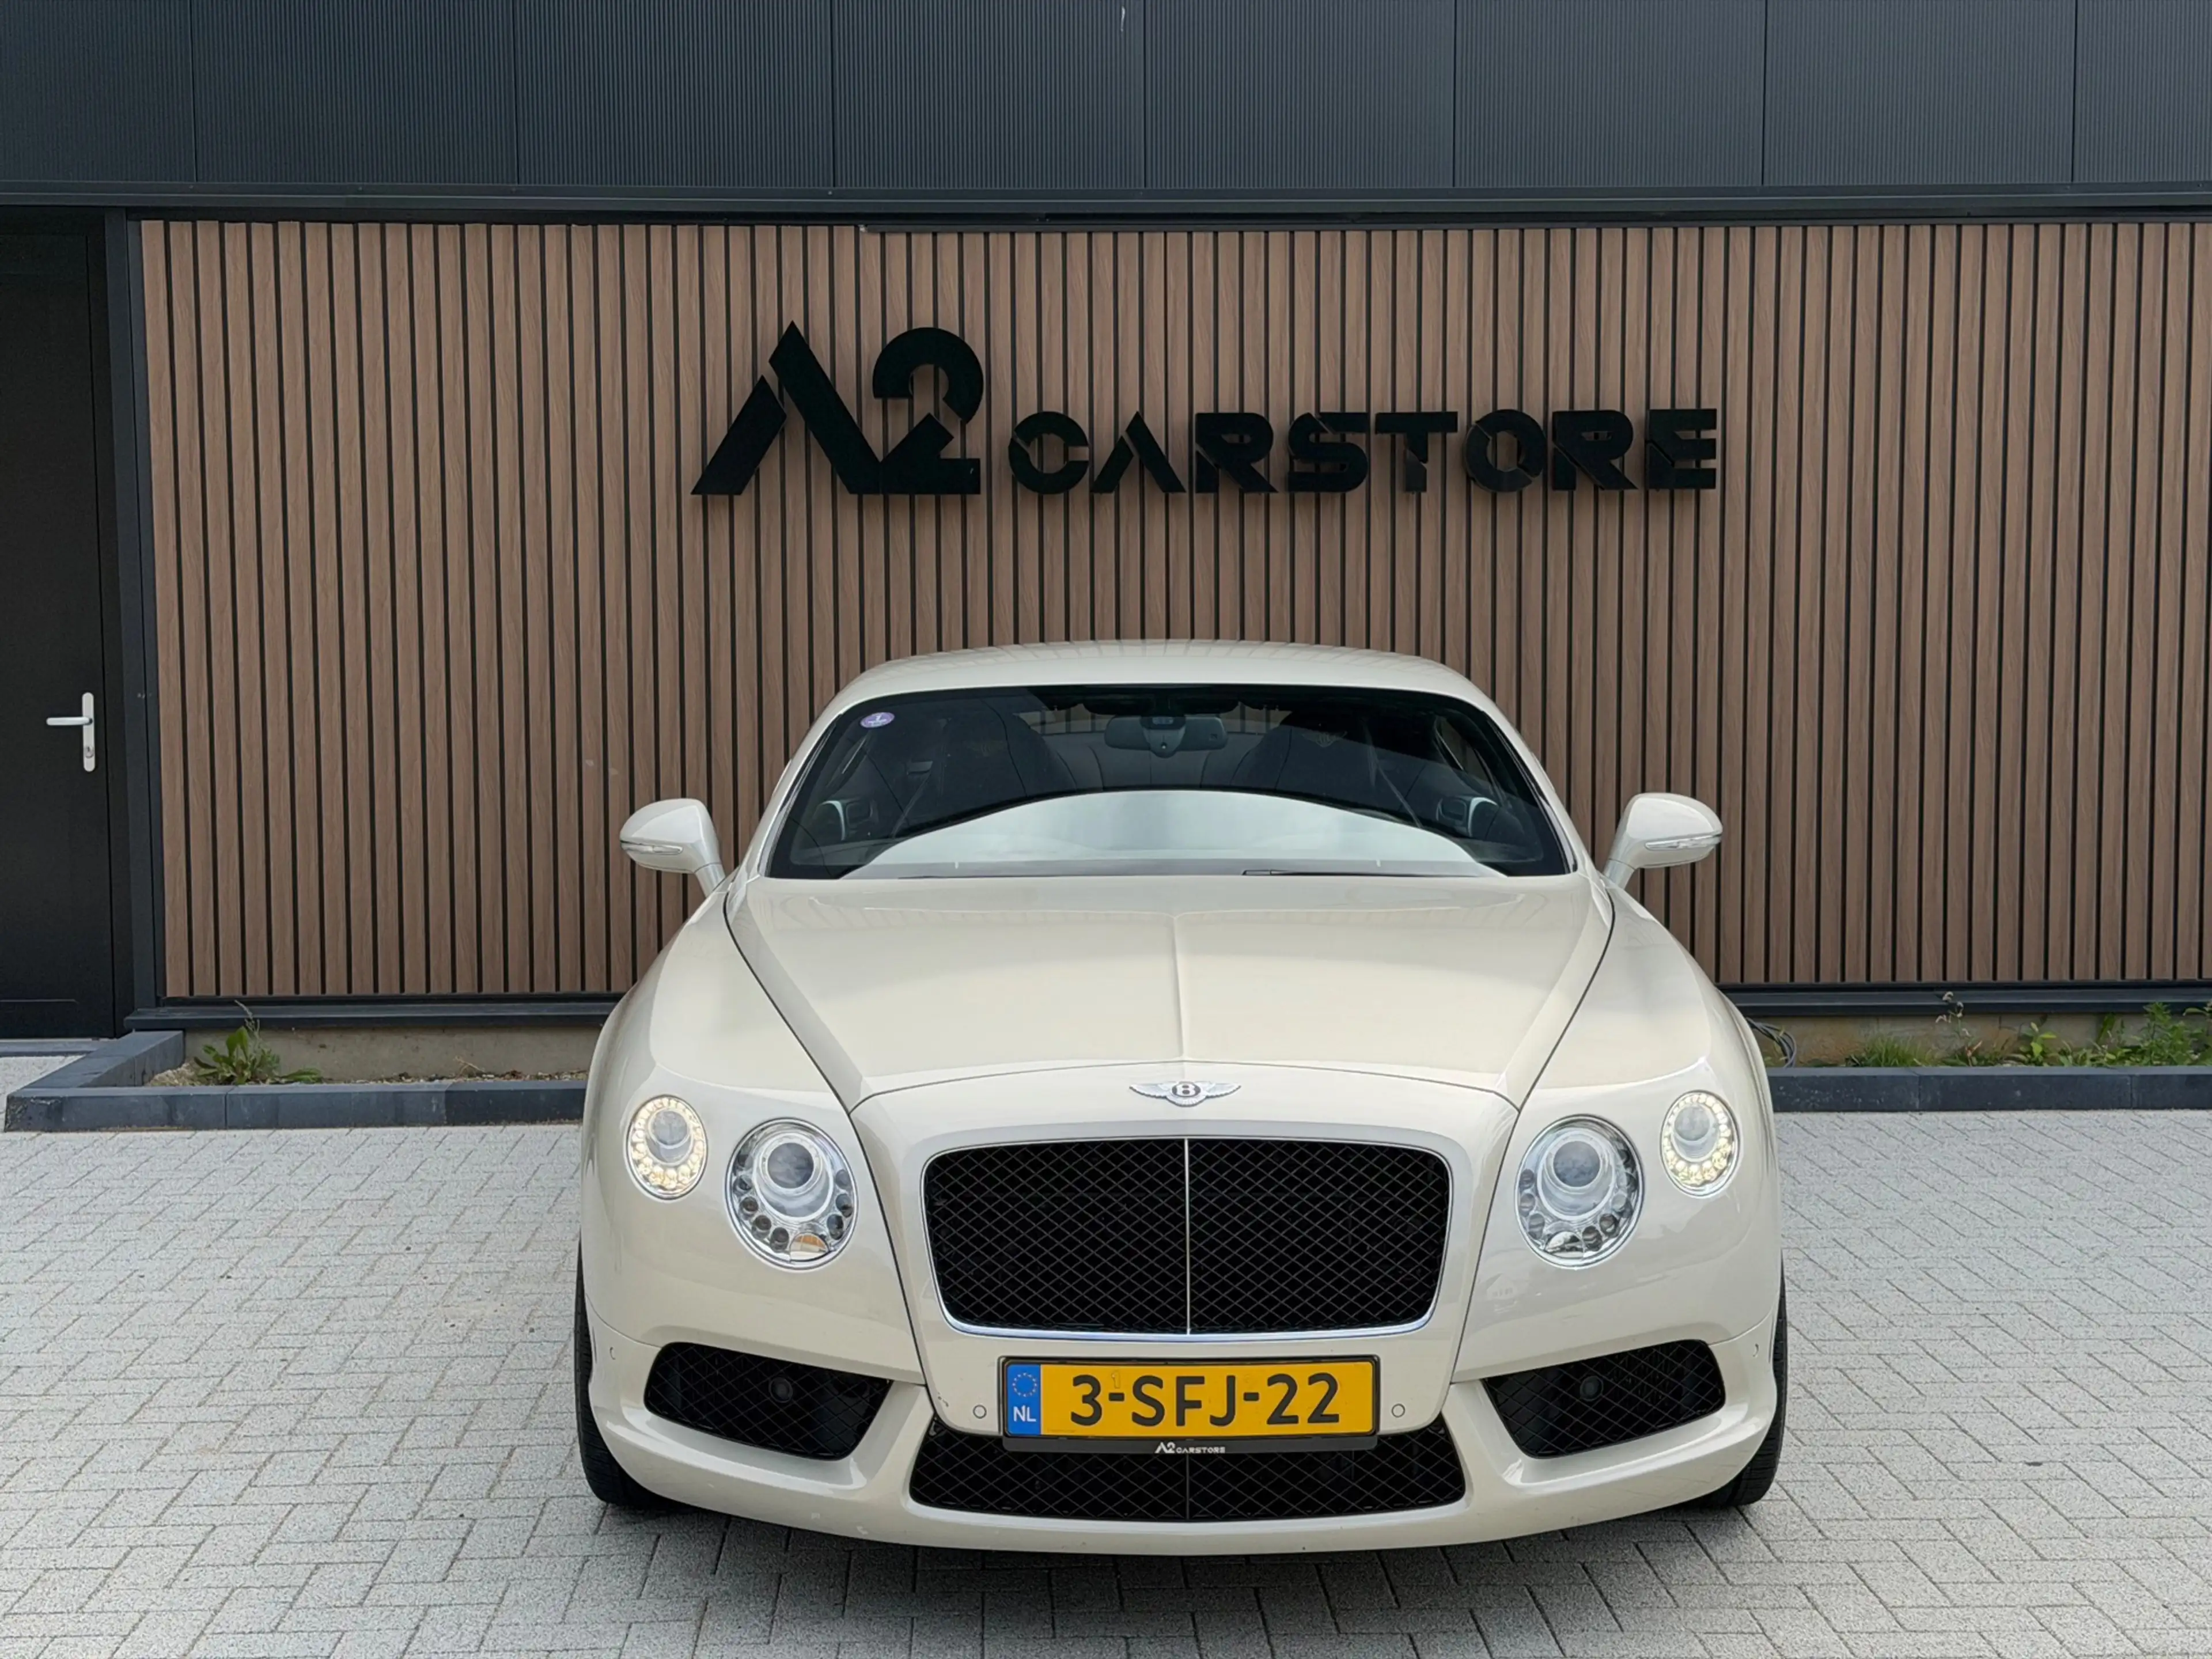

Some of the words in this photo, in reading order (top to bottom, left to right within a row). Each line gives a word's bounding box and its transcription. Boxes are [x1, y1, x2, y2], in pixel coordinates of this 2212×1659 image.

[691, 320, 983, 495] A2
[1008, 410, 1717, 495] CARSTORE
[1177, 1084, 1195, 1097] B
[1071, 1373, 1340, 1426] 3-SFJ-22
[1014, 1406, 1036, 1423] NL
[1154, 1442, 1176, 1454] A2
